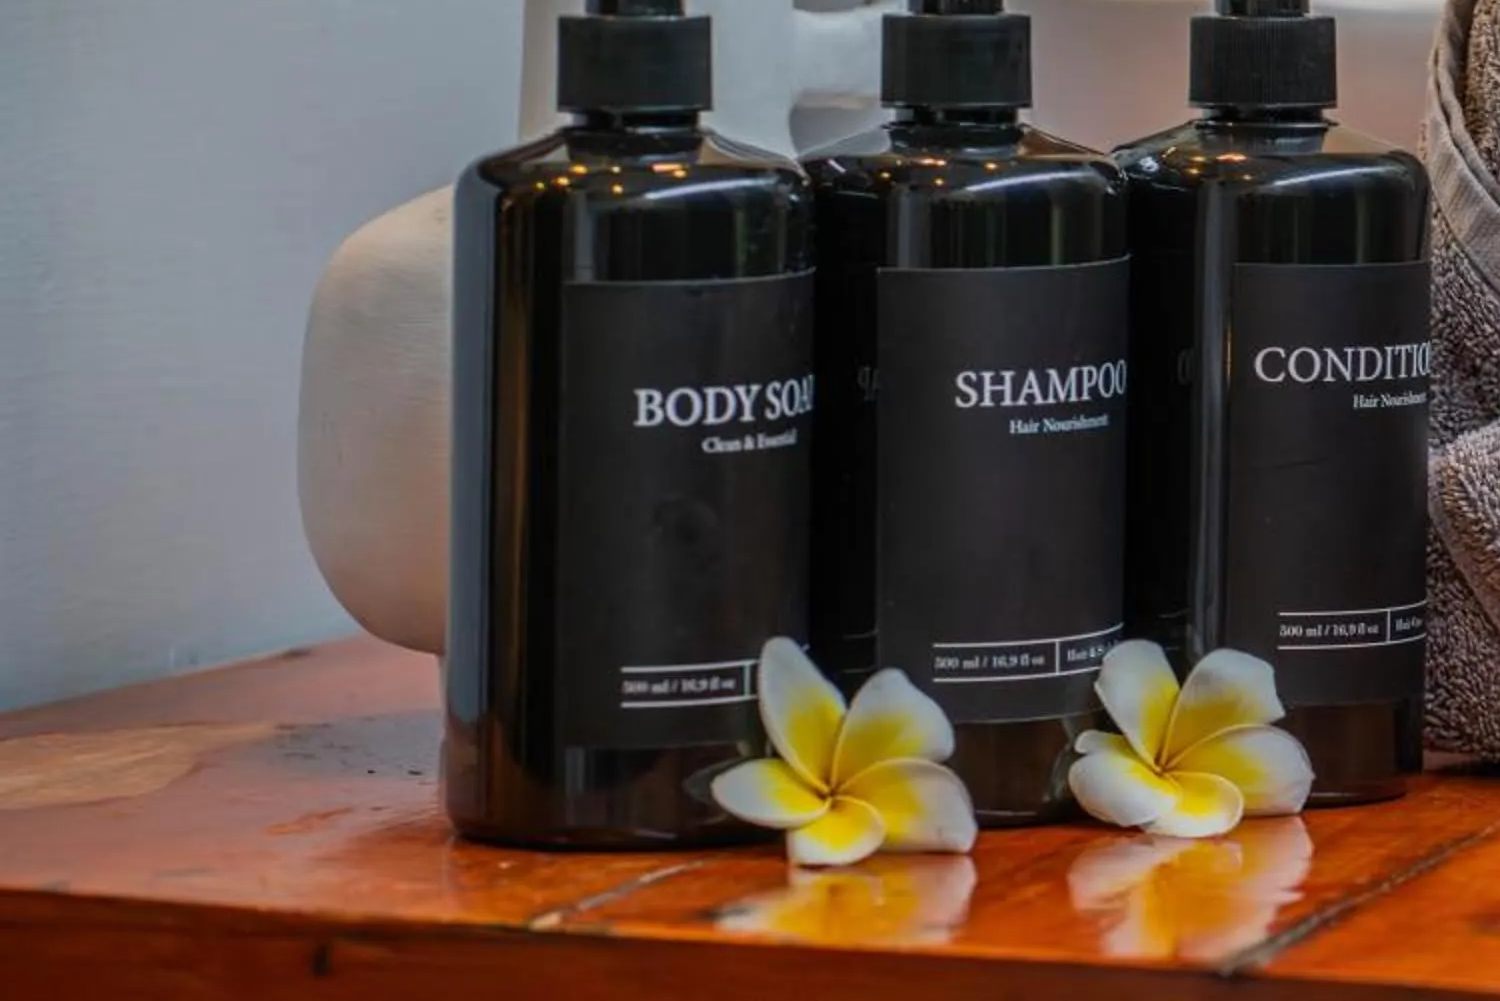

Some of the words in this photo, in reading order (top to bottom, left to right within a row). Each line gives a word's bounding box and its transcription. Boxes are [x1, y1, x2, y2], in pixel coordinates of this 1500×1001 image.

[1254, 340, 1432, 384] CONDITIO
[955, 359, 1127, 408] SHAMPOO
[633, 383, 762, 427] BODY
[1353, 393, 1380, 409] Hair
[1009, 417, 1039, 435] Hair
[1305, 624, 1323, 637] ml
[962, 655, 980, 669] ml
